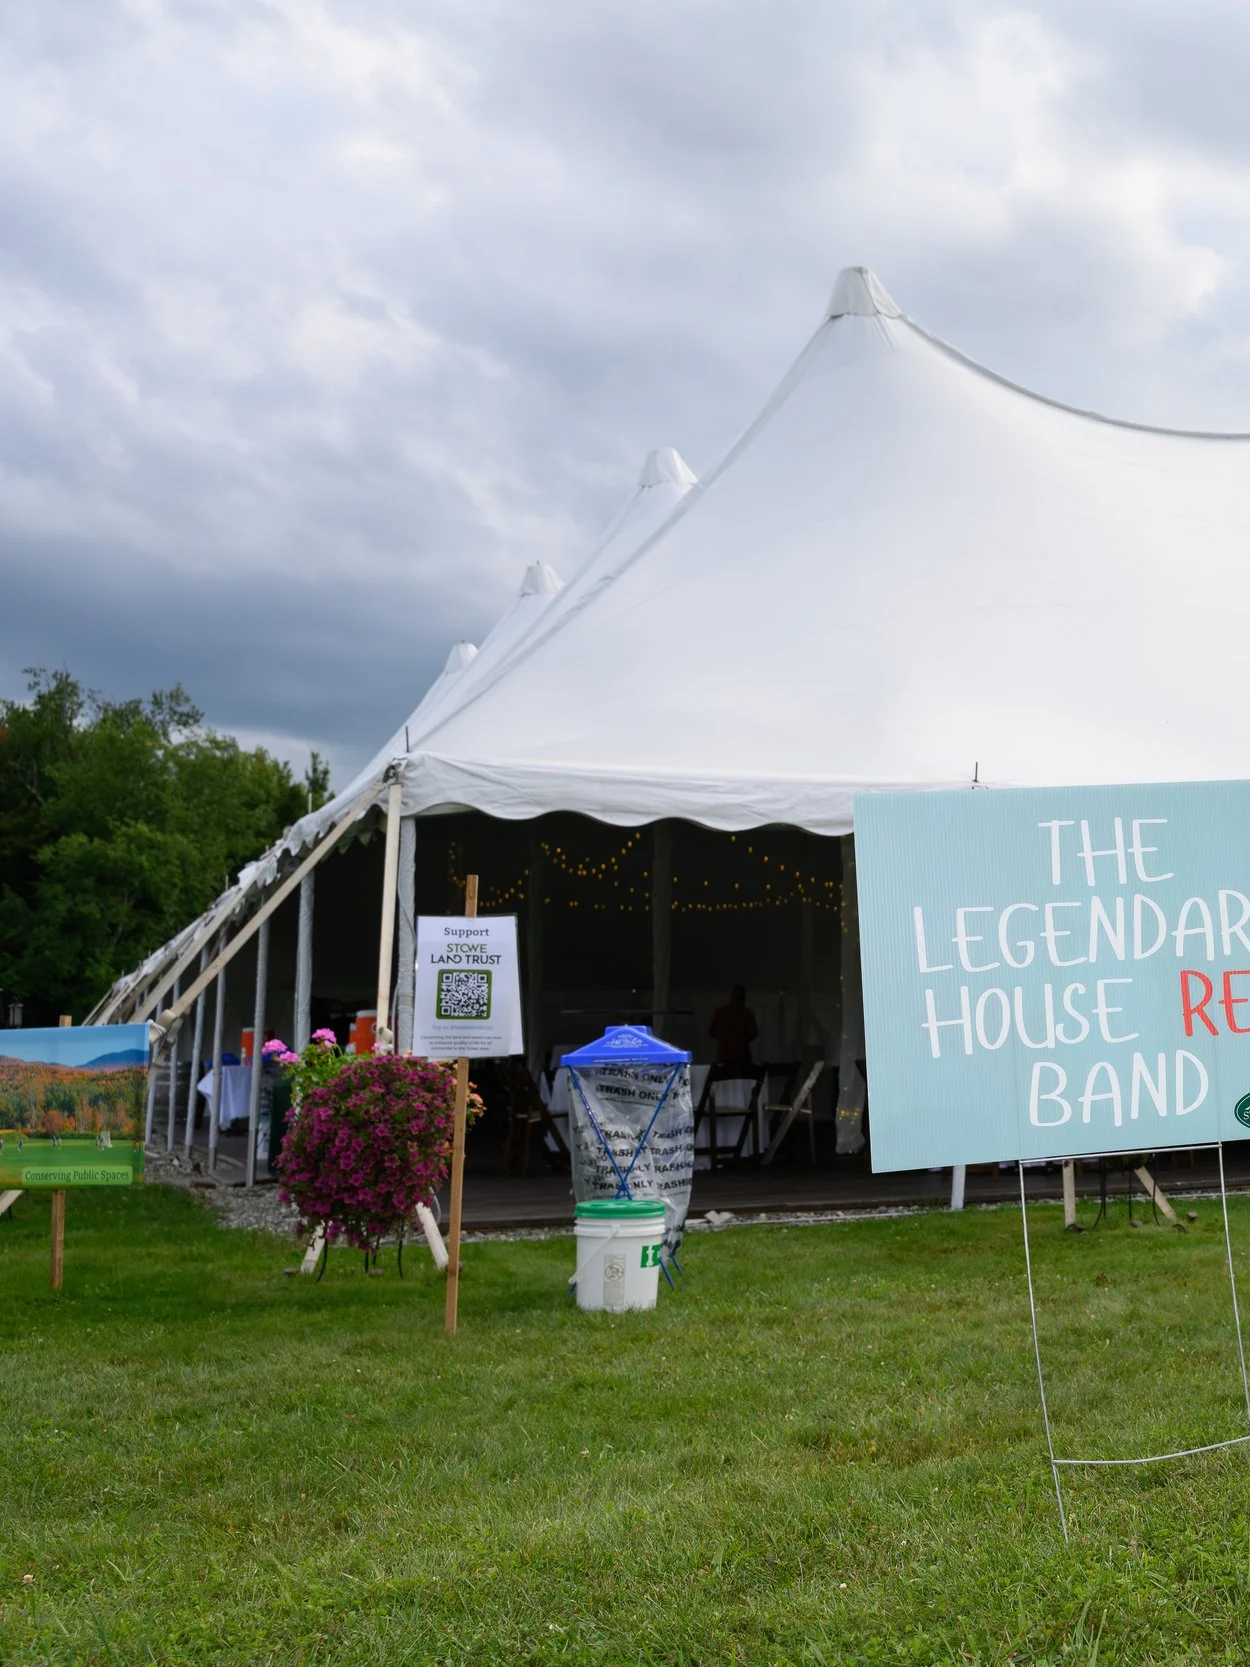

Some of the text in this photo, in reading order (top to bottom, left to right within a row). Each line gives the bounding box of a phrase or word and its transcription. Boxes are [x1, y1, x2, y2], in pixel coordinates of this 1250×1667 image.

[1037, 817, 1175, 886] THE
[444, 927, 490, 938] Support
[446, 943, 488, 953] STOWE
[430, 954, 502, 965] LAND TRUST
[921, 978, 1140, 1058] HOUSE
[598, 1084, 637, 1097] TRASH
[1029, 1049, 1210, 1127] BAND
[650, 1145, 683, 1157] TRASH
[25, 1169, 130, 1183] Conserving Public Spaces
